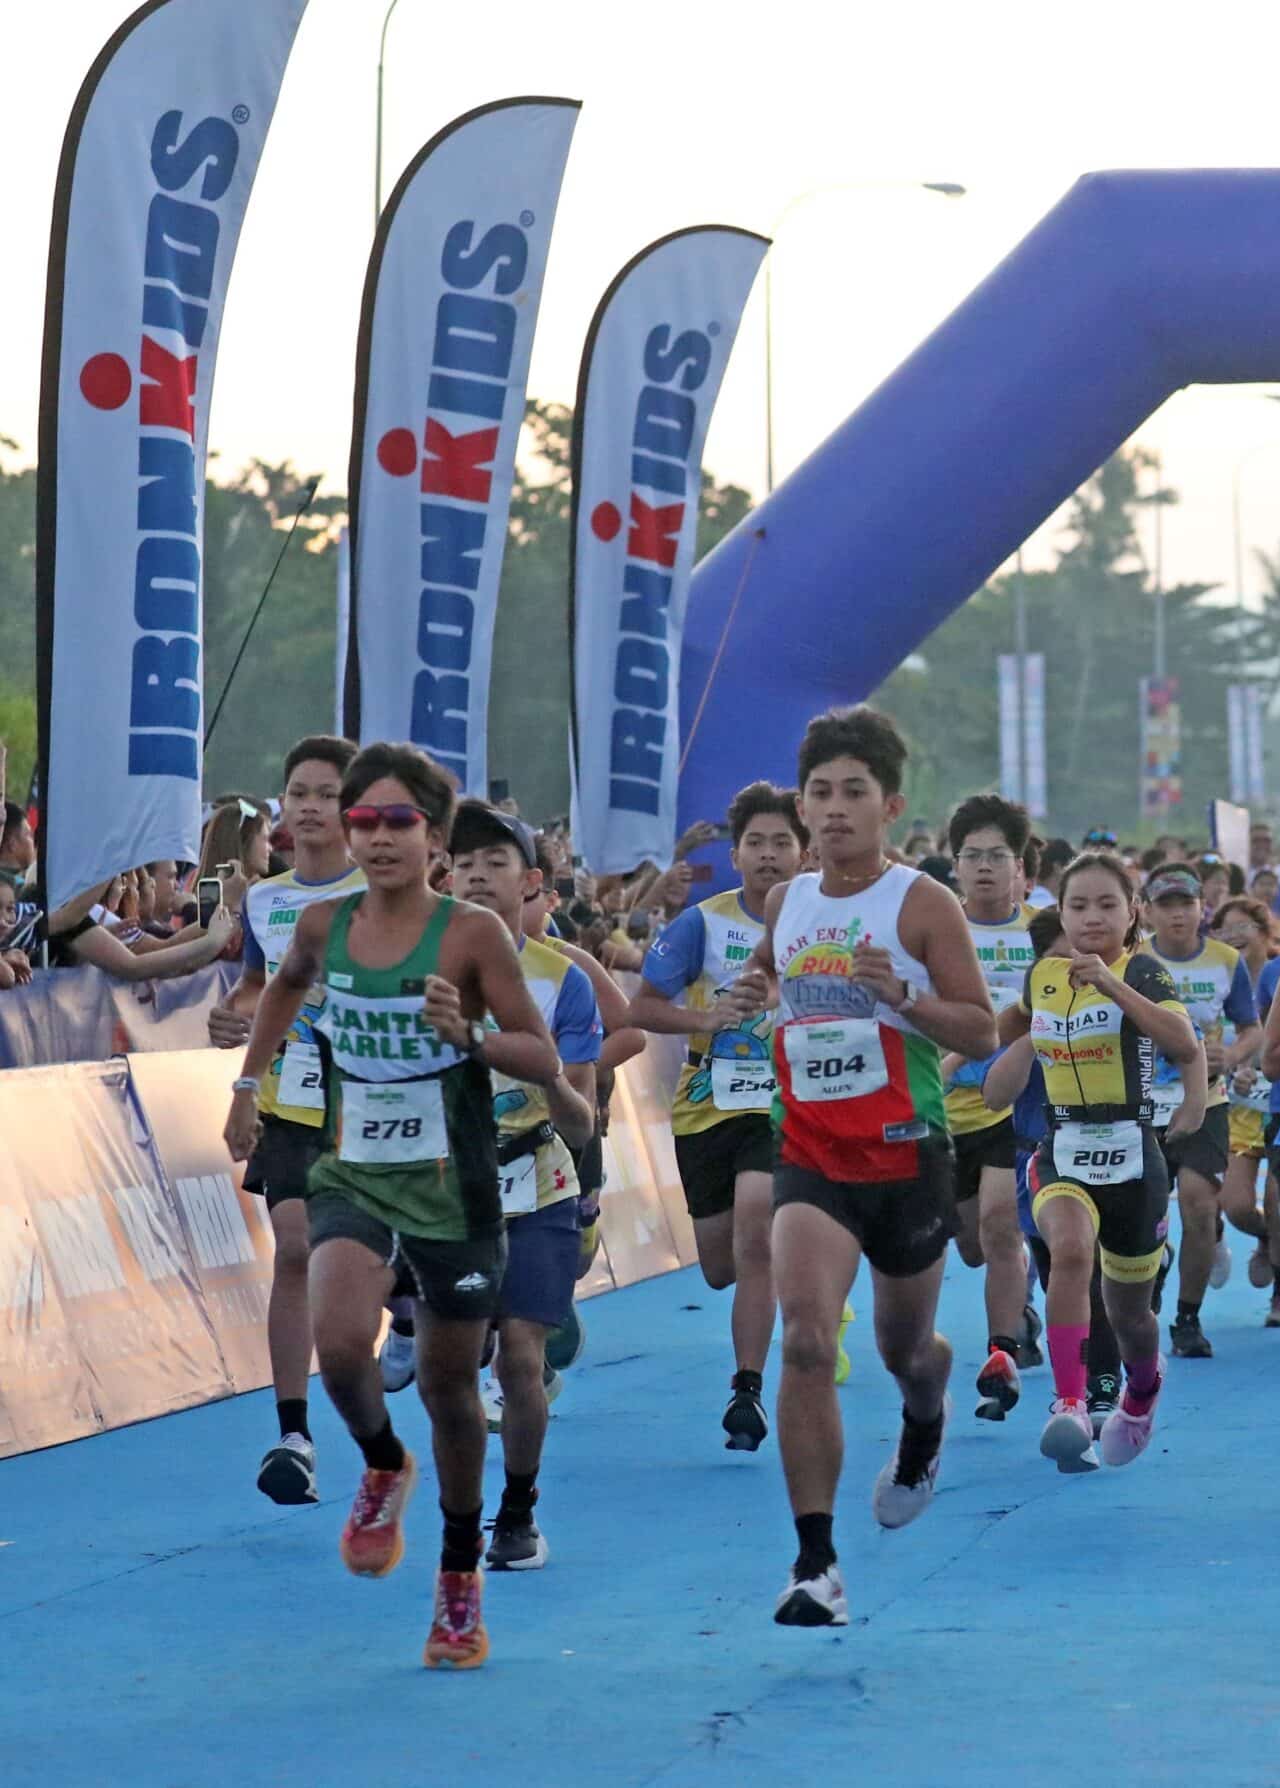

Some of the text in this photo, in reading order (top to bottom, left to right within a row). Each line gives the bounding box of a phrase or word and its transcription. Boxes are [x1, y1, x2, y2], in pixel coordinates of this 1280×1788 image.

[591, 323, 712, 816] IRONKIDS
[816, 928, 848, 942] END
[801, 956, 848, 975] RUN
[1053, 1010, 1109, 1032] TRIAD
[334, 1034, 442, 1061] ARLEY
[806, 1054, 865, 1078] 204
[1137, 1037, 1153, 1099] PILIPINAS
[362, 1118, 423, 1140] 278
[1073, 1149, 1127, 1166] 206
